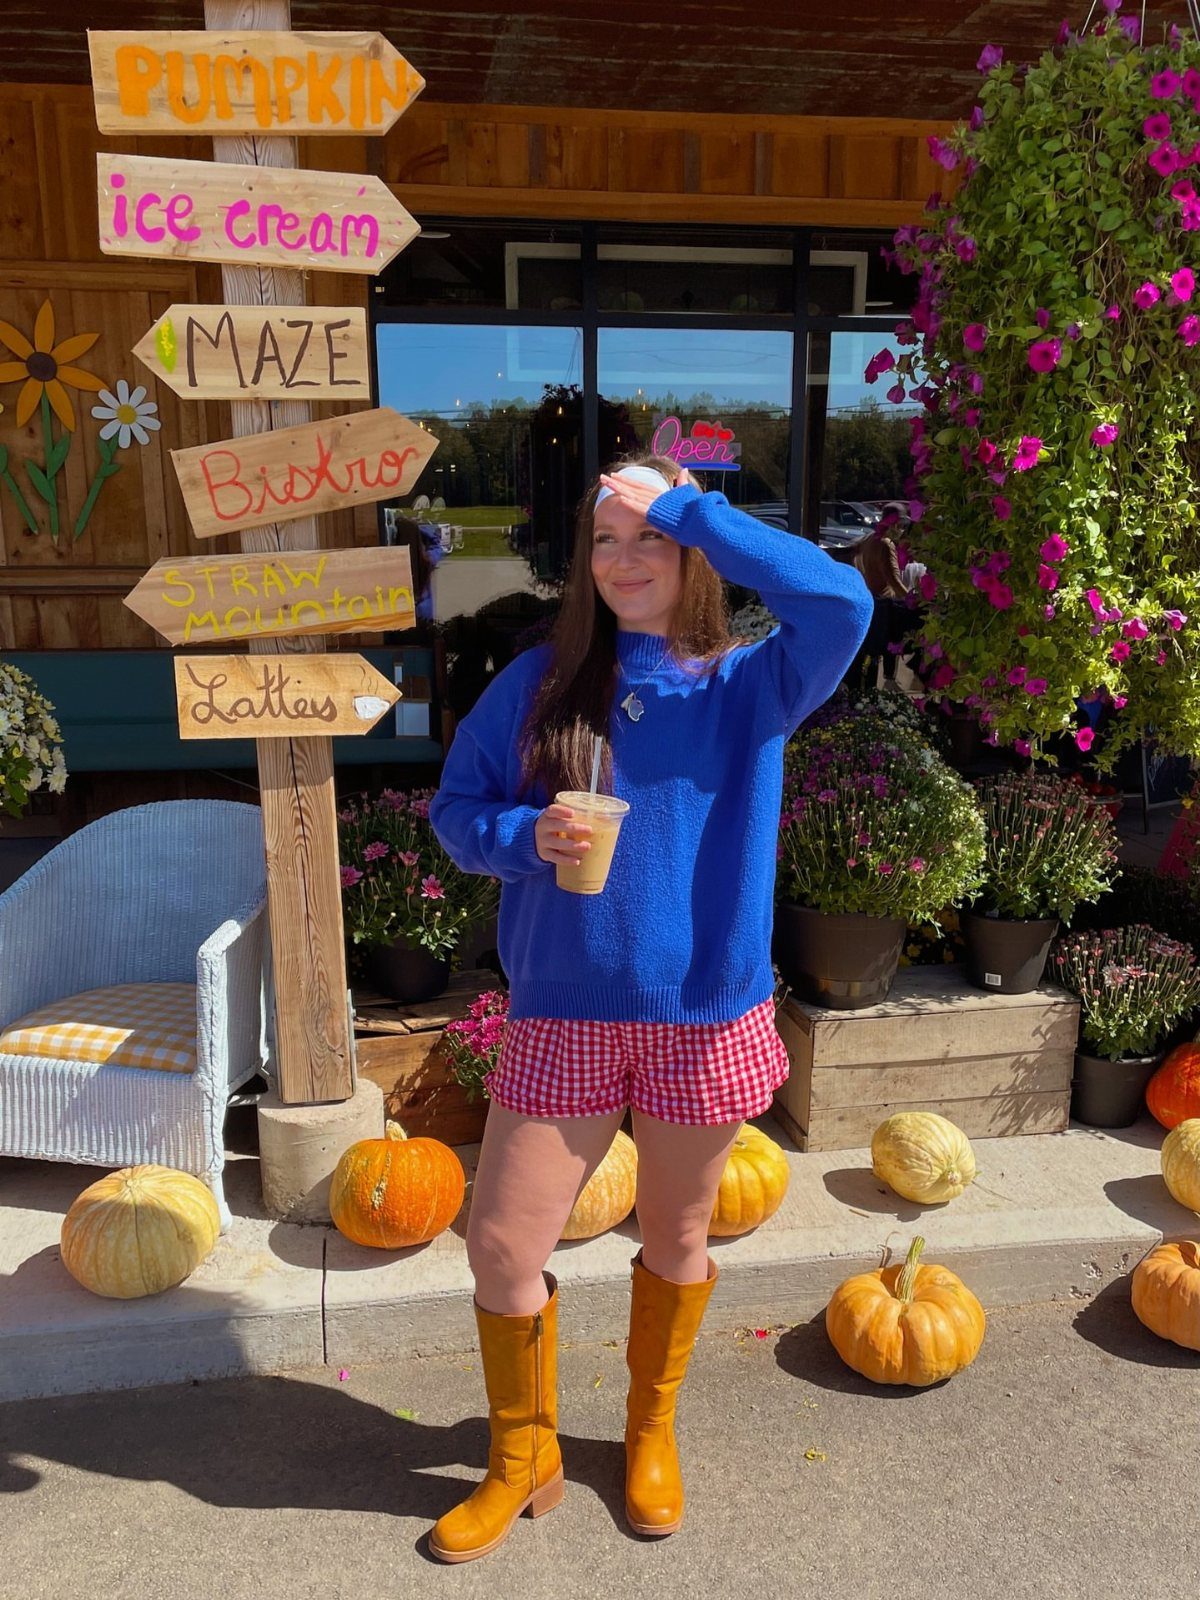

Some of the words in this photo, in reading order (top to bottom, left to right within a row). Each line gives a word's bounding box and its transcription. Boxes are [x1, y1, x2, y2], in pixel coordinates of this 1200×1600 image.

[110, 173, 201, 243] ice
[218, 199, 379, 258] cream
[186, 311, 361, 389] MAZE
[652, 417, 735, 463] Open
[201, 434, 420, 520] Bistro
[161, 556, 327, 607] STRAW
[185, 663, 337, 724] Lattes
